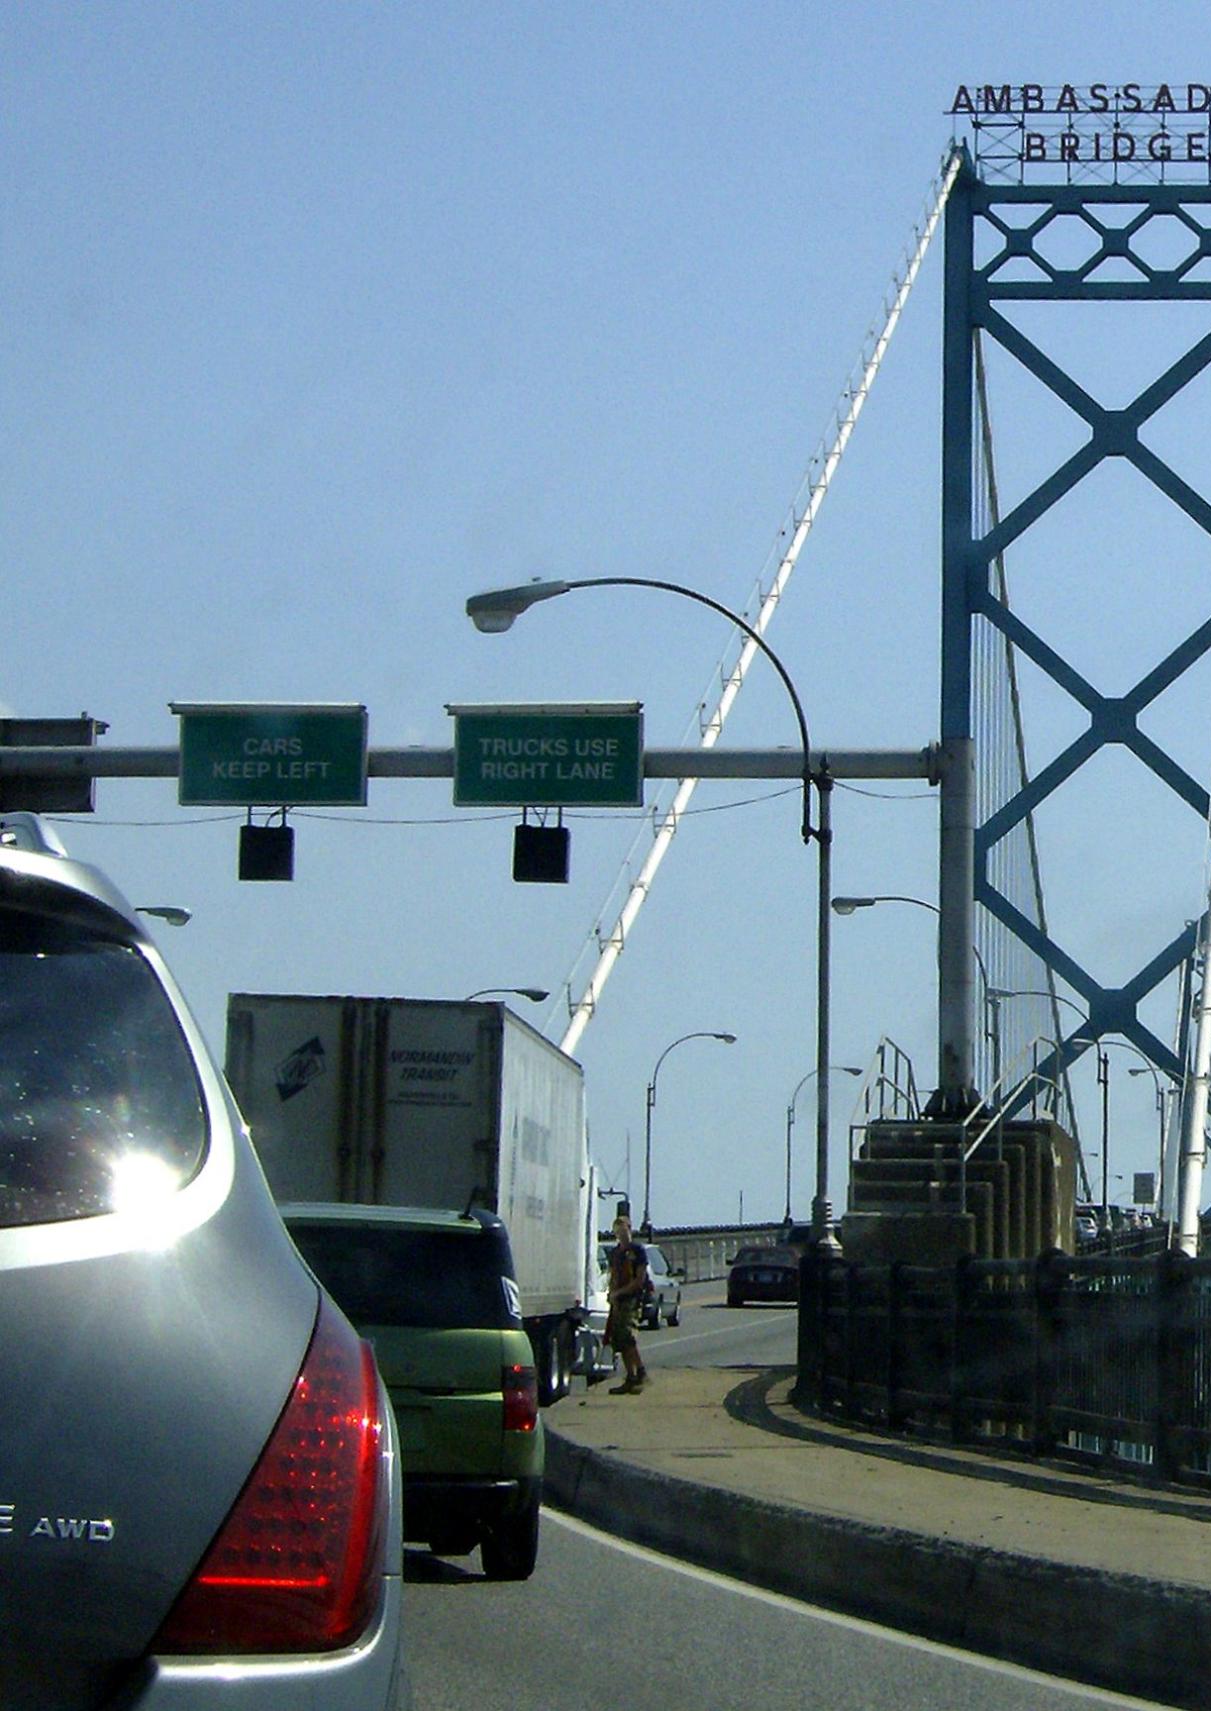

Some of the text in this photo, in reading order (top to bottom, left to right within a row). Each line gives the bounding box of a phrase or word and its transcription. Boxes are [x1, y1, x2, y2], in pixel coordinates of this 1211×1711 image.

[1026, 133, 1207, 161] BRIDGE
[243, 738, 303, 756] CARS
[479, 738, 619, 756] TRUCKS USE
[213, 761, 331, 779] KEEP LEFT
[481, 762, 615, 779] RIGHT LANE
[400, 1067, 458, 1081] TRANSIT
[30, 1517, 115, 1541] AWD
